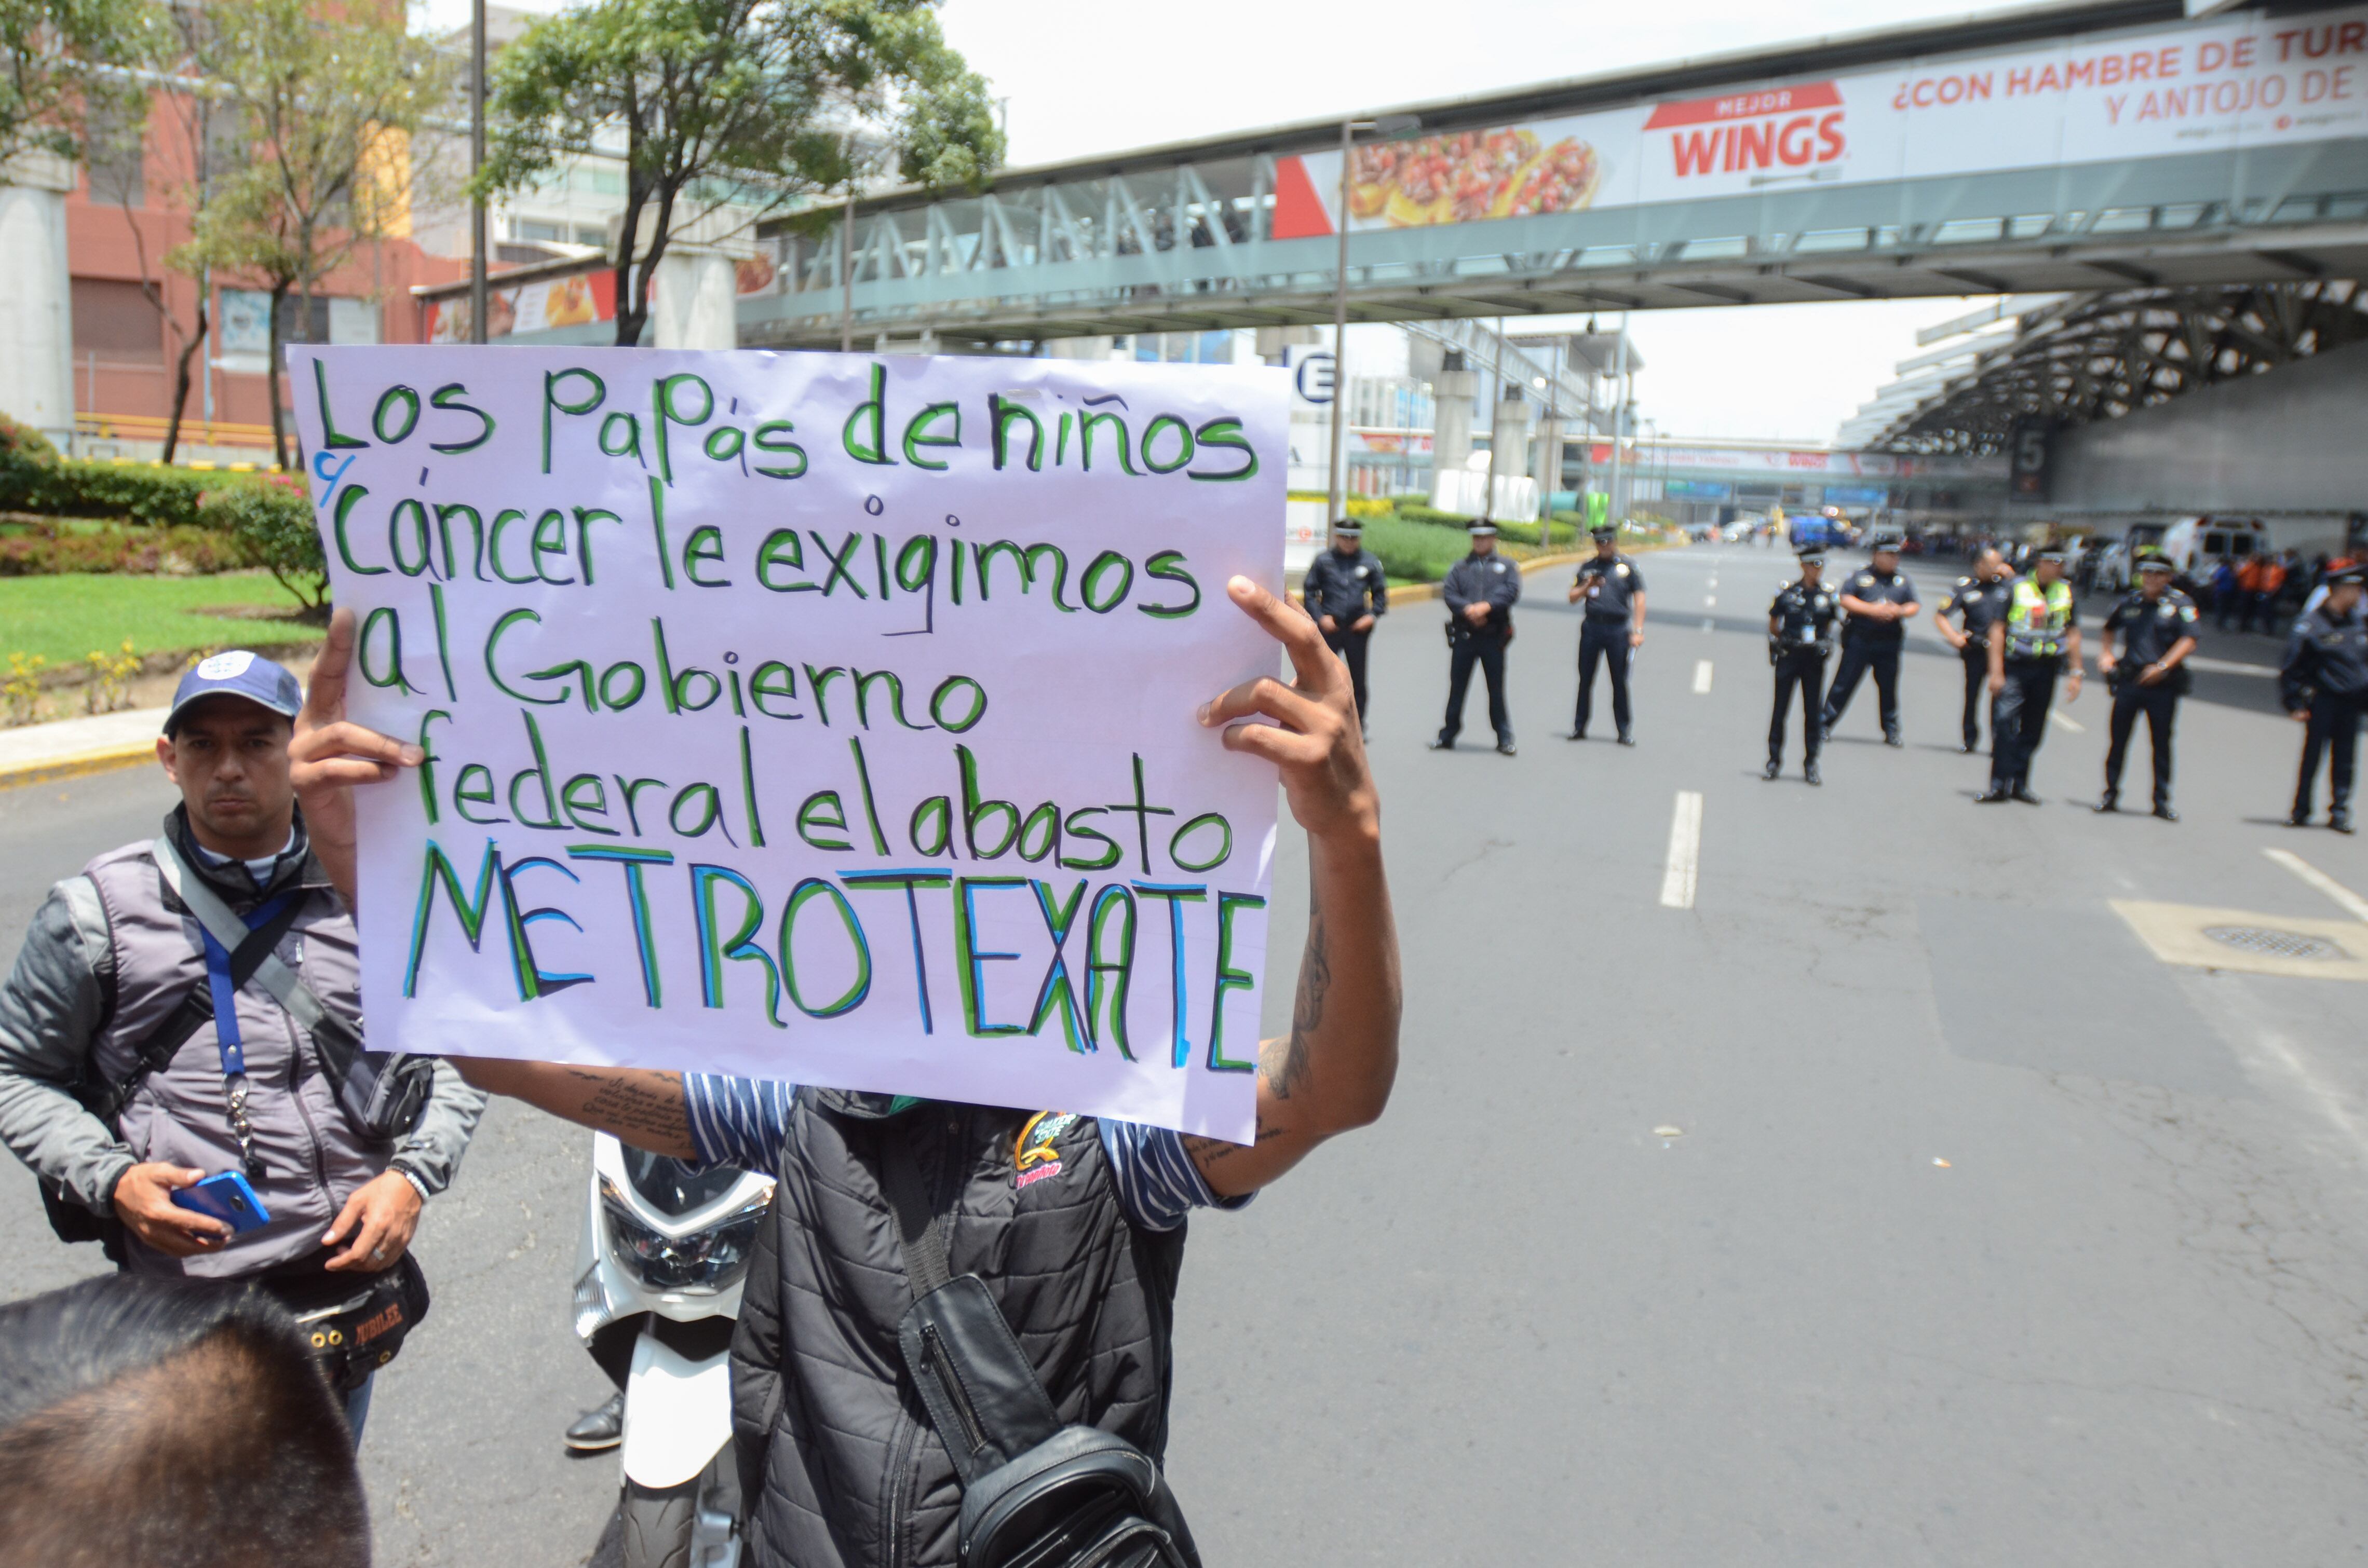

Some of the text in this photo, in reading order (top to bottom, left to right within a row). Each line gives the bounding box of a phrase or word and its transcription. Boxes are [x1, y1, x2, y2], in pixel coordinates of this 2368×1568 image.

[1717, 91, 1792, 117] MEJOR
[1892, 71, 1993, 111] ¿CON
[2006, 45, 2183, 98] HAMBRE
[2196, 36, 2257, 74] DE
[2105, 93, 2127, 126] Y
[2136, 74, 2286, 122] ANTOJO
[2299, 65, 2356, 103] DE
[1671, 111, 1846, 178] WINGS
[313, 358, 496, 455] Los
[843, 362, 962, 471] de
[987, 393, 1259, 481] niños
[648, 475, 732, 590] le
[756, 494, 1201, 636] exigimos
[358, 582, 988, 733] al Gobierno
[415, 709, 766, 848] federal
[909, 743, 1233, 876] abasto
[403, 837, 1267, 1073] METROTEXATE
